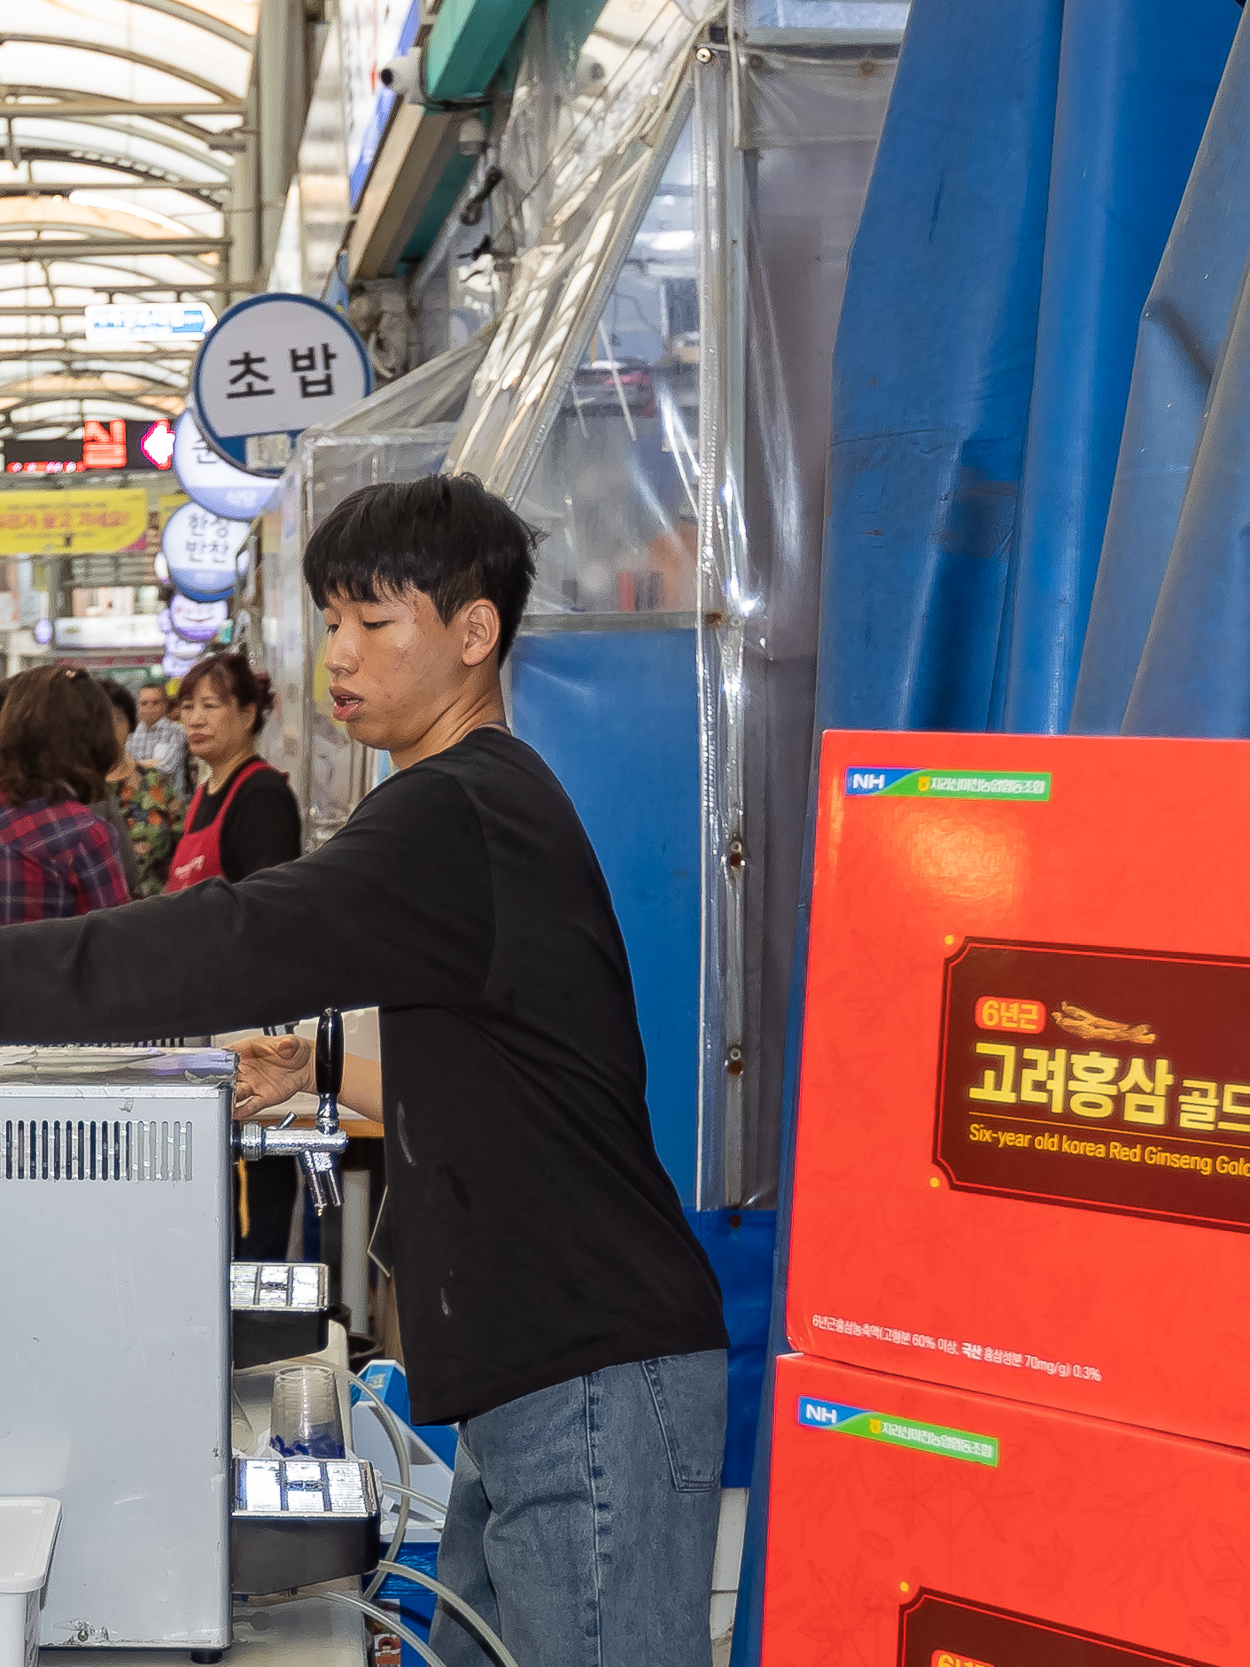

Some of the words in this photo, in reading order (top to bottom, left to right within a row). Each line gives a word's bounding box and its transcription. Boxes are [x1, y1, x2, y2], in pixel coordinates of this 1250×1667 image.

[226, 342, 338, 400] 초밥
[852, 773, 886, 790] NH
[981, 1000, 1039, 1030] 6년근
[968, 1042, 1175, 1126] 고려홍삼
[969, 1124, 1032, 1147] Six-year
[1034, 1132, 1059, 1151] old
[1061, 1134, 1106, 1158] korea
[1108, 1141, 1142, 1162] Red
[1144, 1146, 1213, 1176] Ginseng
[912, 1333, 936, 1349] 60%
[961, 1342, 983, 1361] 국산
[1072, 1364, 1103, 1382] 0.3%
[806, 1404, 837, 1424] NH
